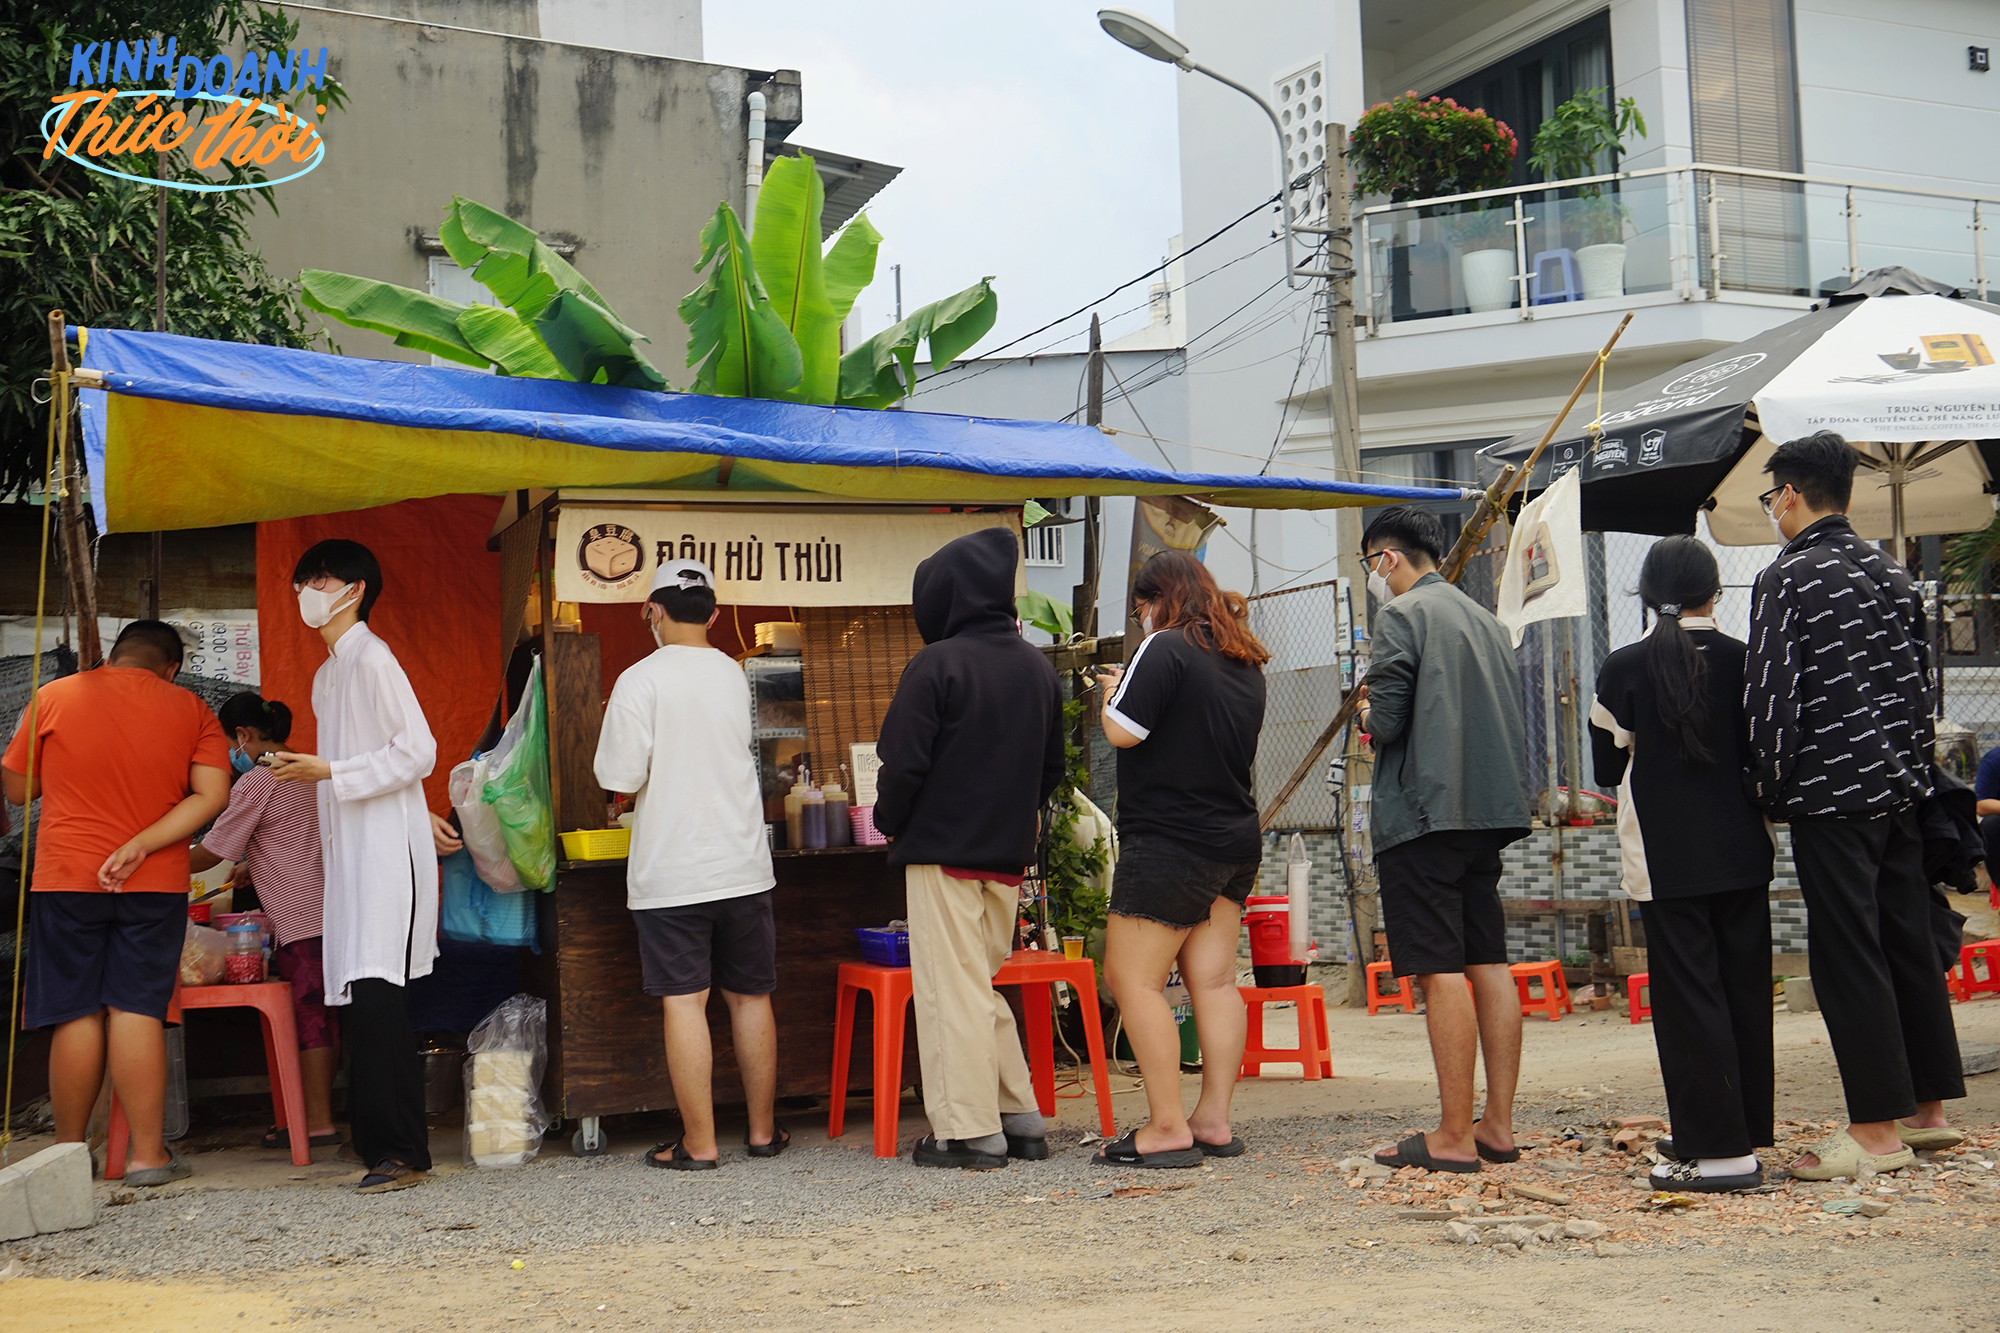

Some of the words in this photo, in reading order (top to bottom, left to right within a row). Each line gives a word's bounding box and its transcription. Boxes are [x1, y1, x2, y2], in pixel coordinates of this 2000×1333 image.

[1886, 405, 1930, 414] TRUNG
[1934, 403, 1986, 413] NGUYÊN
[1862, 413, 1907, 424] CHUYÊN
[1927, 412, 1949, 422] PHÊ
[588, 524, 635, 543] 臭豆腐
[725, 534, 764, 581] HỦ
[774, 536, 842, 582] THÚI
